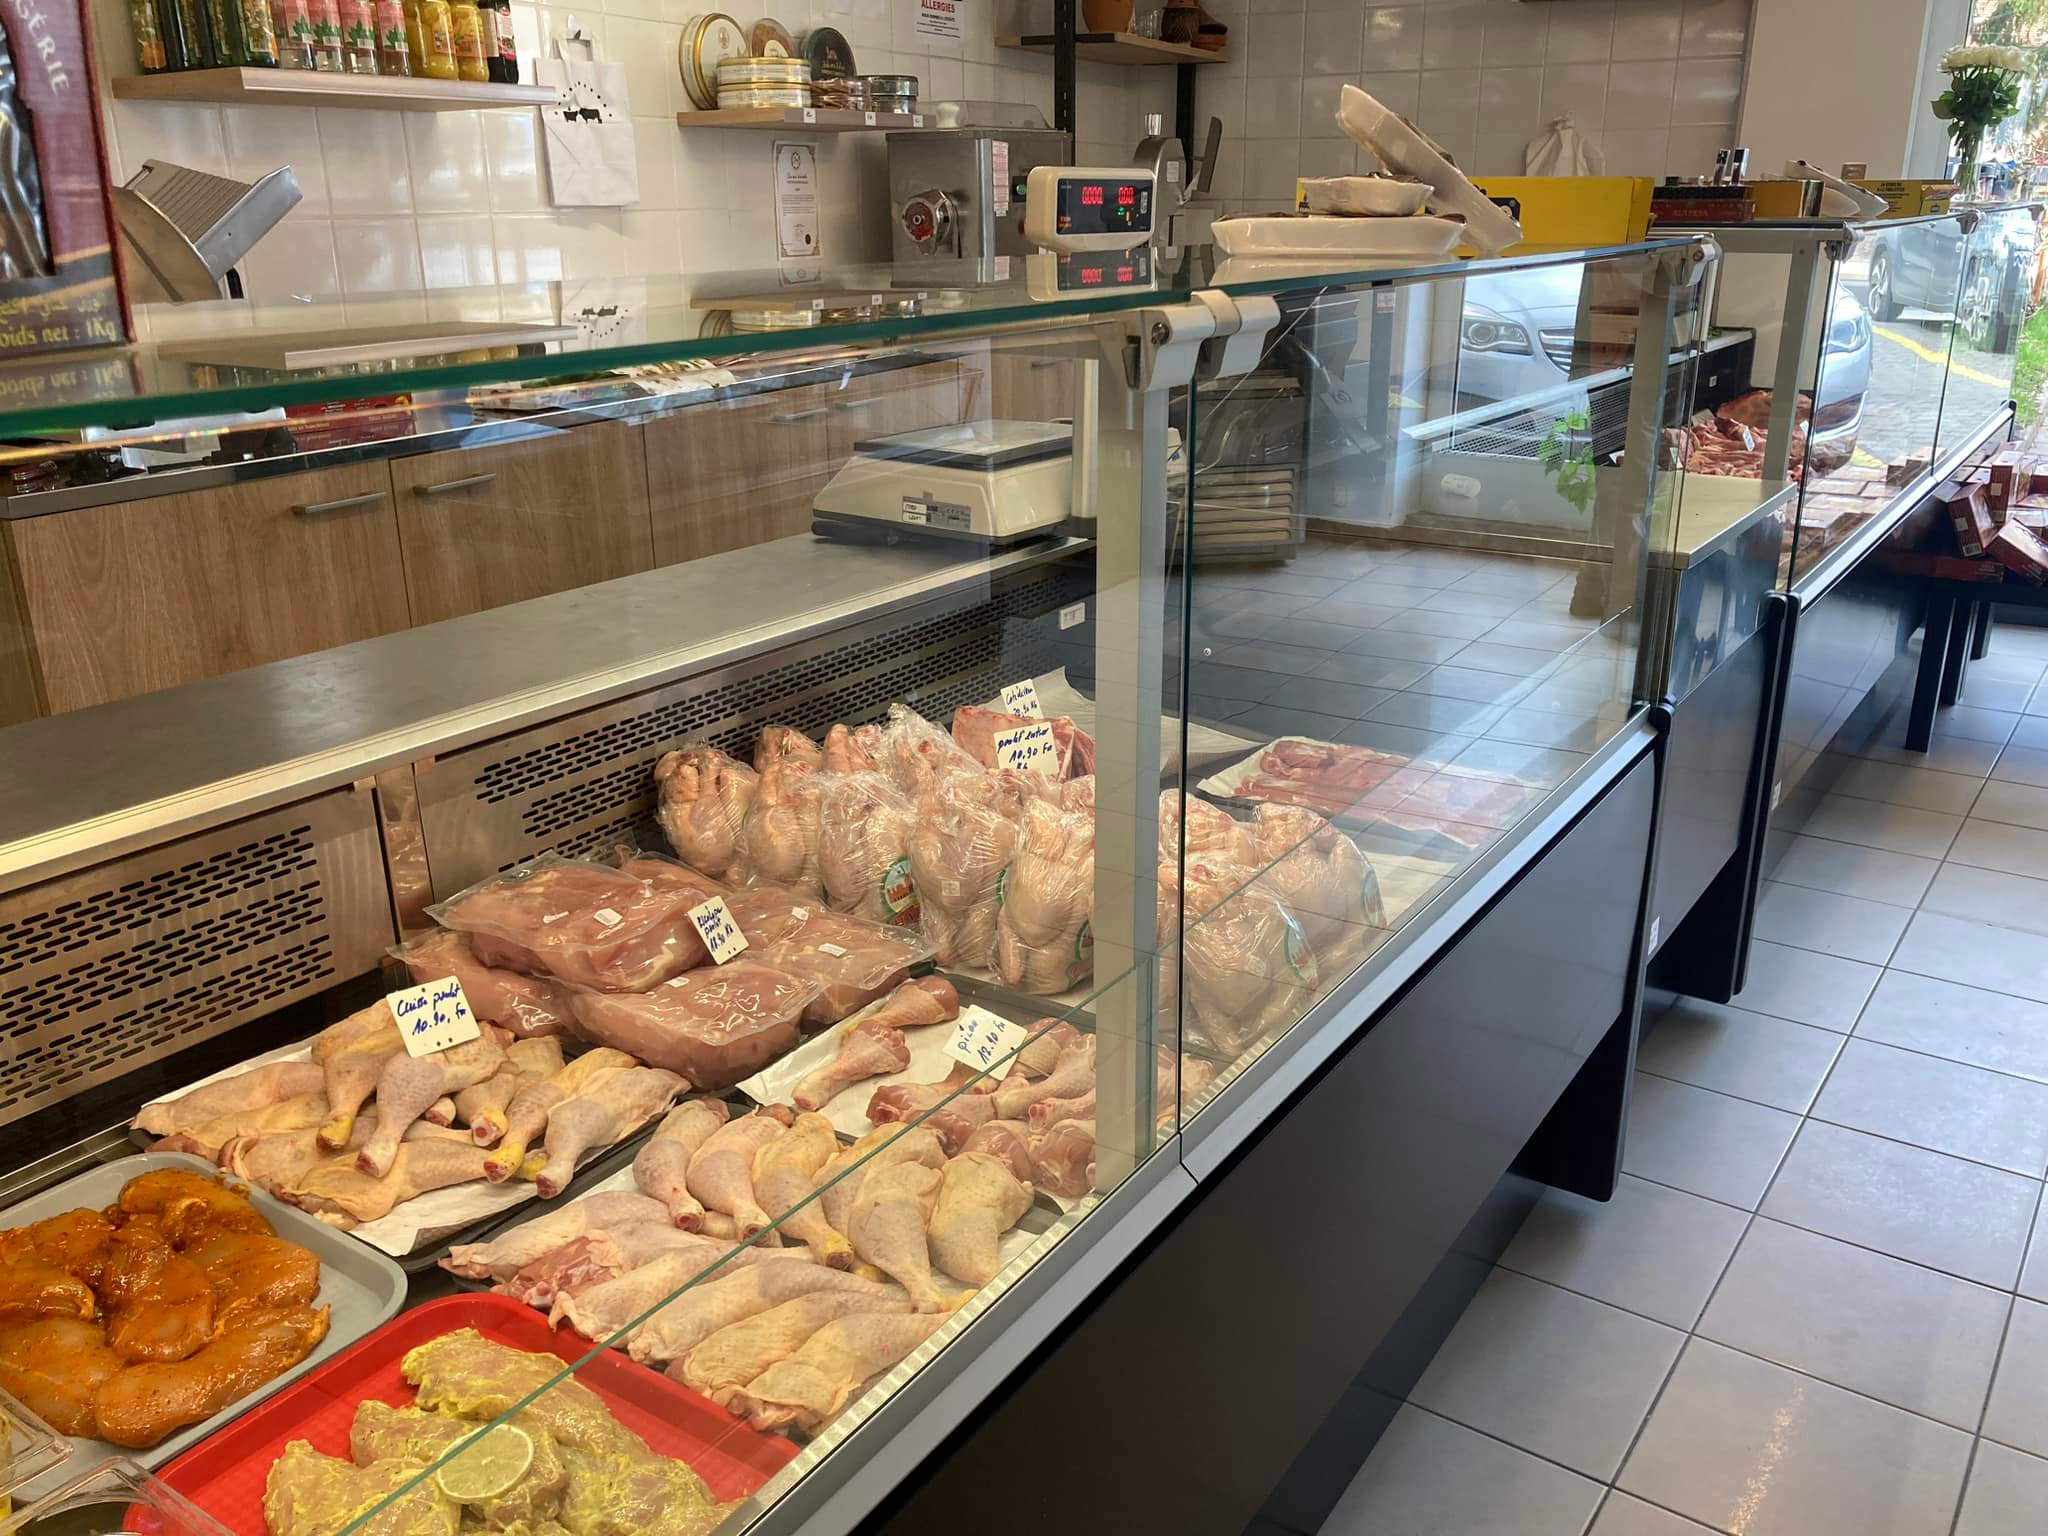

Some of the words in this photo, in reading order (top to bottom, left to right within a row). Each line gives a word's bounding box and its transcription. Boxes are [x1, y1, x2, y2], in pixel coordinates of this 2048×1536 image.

[921, 0, 956, 13] ALLERGIES
[14, 0, 69, 97] GÉRIE
[0, 325, 37, 347] oids
[42, 326, 69, 342] net
